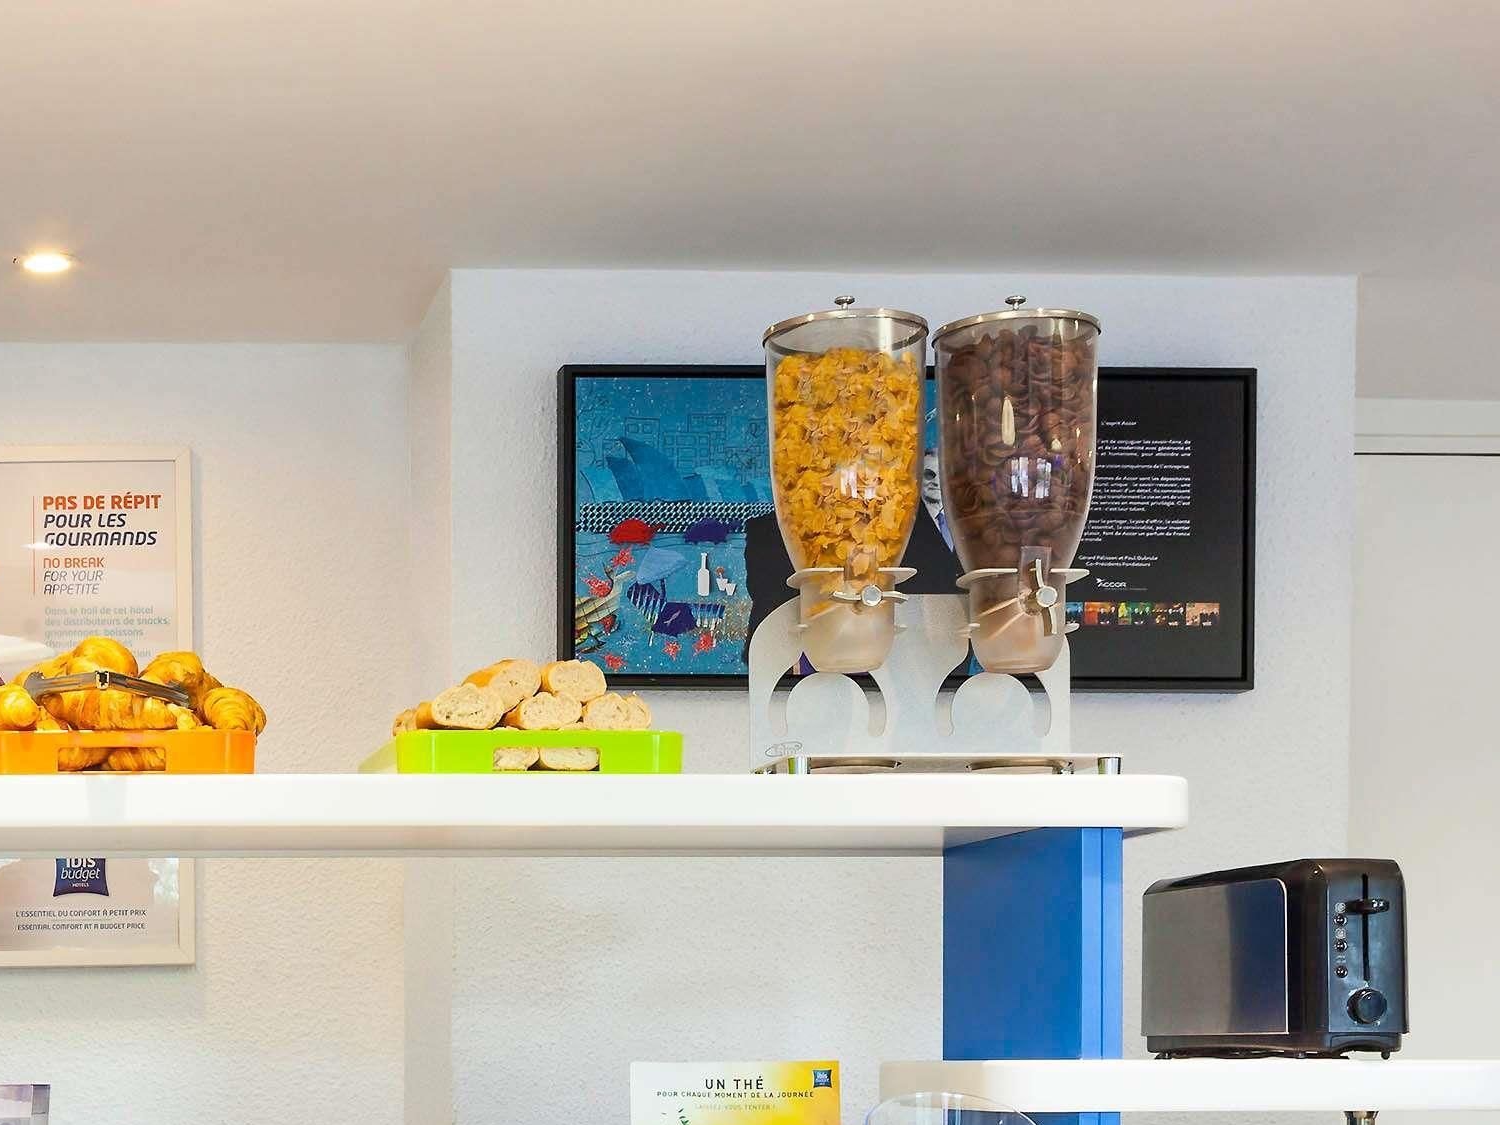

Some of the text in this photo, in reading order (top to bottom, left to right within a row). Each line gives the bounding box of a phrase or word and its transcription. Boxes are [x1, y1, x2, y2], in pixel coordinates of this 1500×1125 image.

[42, 491, 162, 510] PAS DE RÉPIT
[43, 513, 127, 528] POUR LES
[44, 531, 158, 546] GOURMANDS
[64, 557, 105, 568] BREAK
[43, 569, 104, 582] FOR YOUR
[43, 583, 101, 595] APPETITE
[63, 616, 121, 626] distributeurs
[123, 616, 135, 626] de
[61, 867, 100, 882] budget
[69, 909, 100, 917] CONFORT
[705, 1076, 764, 1090] UN THÉ
[777, 1090, 814, 1098] JOURNÉE
